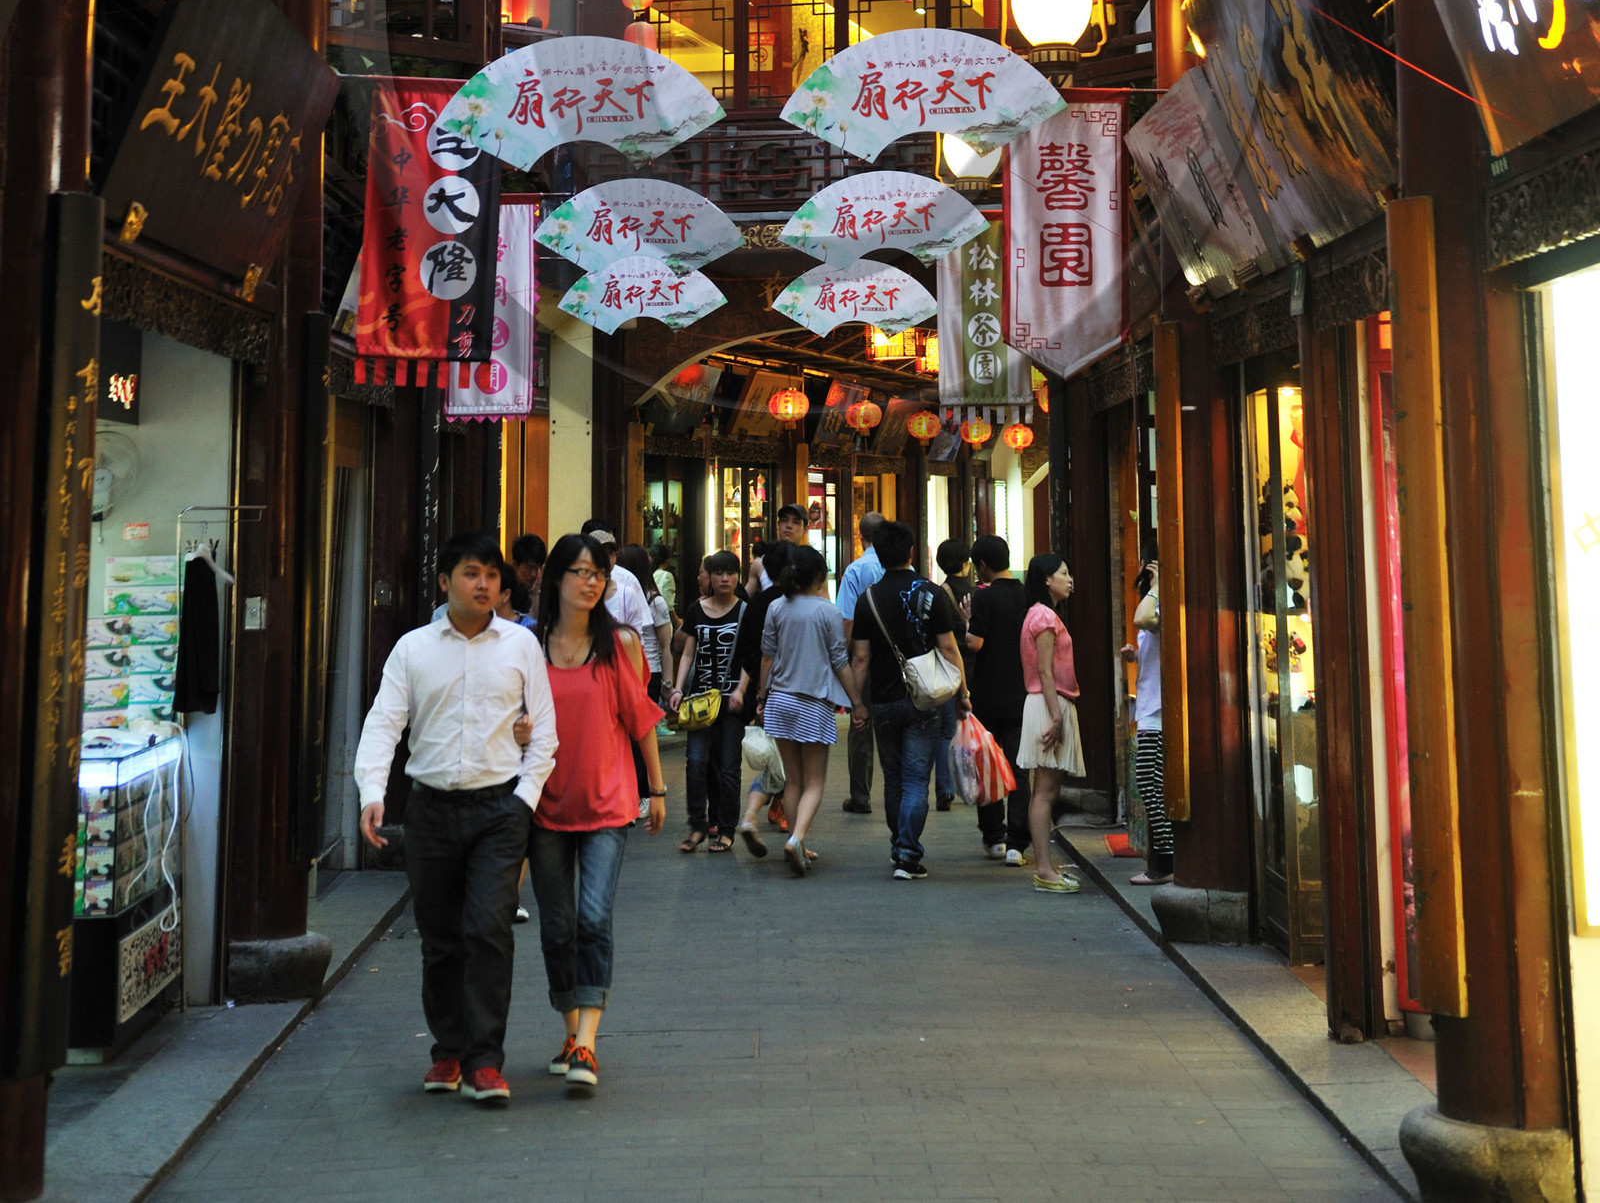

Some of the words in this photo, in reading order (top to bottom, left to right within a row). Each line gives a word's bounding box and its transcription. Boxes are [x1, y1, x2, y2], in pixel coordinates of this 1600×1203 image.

[507, 69, 655, 135] 扇行天下
[851, 61, 996, 127] 扇行天下
[140, 52, 304, 217] 王大隆刀剪店
[382, 147, 412, 332] 中华老字号
[586, 201, 694, 251] 扇行天下
[831, 196, 937, 244] 扇行天下
[600, 274, 686, 314] 扇行天下
[815, 277, 900, 317] 扇行天下
[968, 242, 1002, 384] 松林茶園
[452, 304, 475, 357] 刀剪
[699, 643, 711, 655] A
[716, 622, 738, 645] ON
